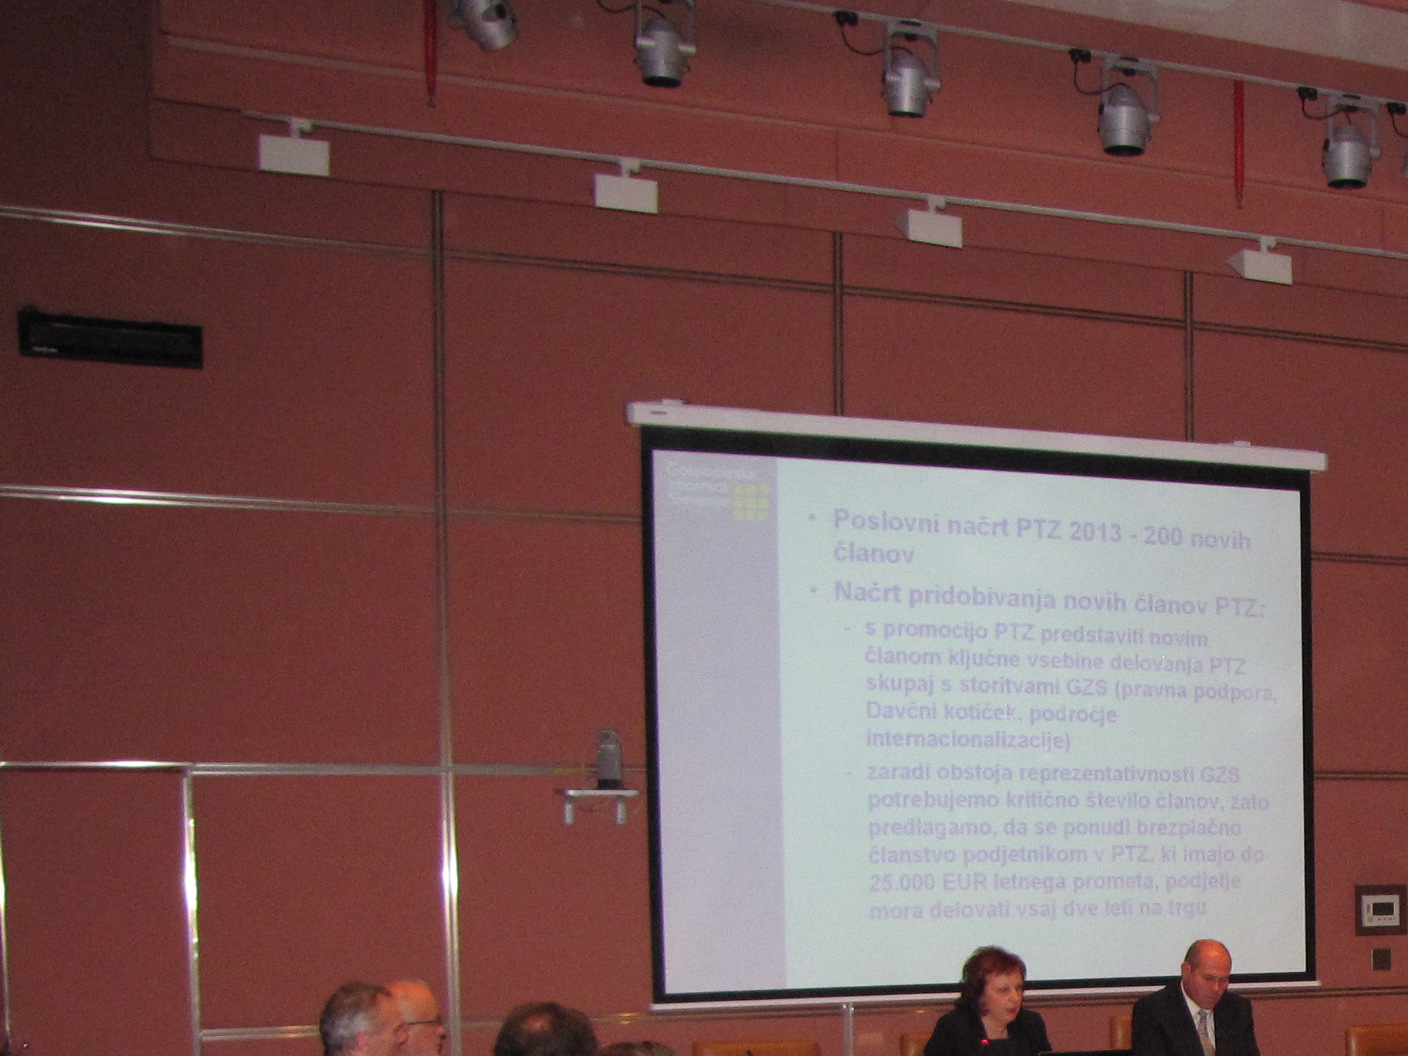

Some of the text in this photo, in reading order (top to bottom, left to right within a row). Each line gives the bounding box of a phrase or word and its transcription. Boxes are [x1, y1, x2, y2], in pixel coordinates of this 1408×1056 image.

[833, 507, 940, 535] Poslovni
[947, 514, 1011, 539] načrt
[1015, 516, 1063, 542] PTZ
[1068, 519, 1122, 544] 2013
[1142, 524, 1183, 547] 200
[1190, 528, 1251, 551] novih
[832, 540, 915, 566] članov
[834, 579, 902, 604] Načrt
[908, 582, 1057, 614] pridobivanja
[1063, 589, 1126, 612] novih
[1134, 593, 1208, 616] članov
[864, 619, 1209, 648] s promocijo PTZ predstaviti novim
[863, 644, 1247, 676] članom ključne vsebine delovanja PTZ
[865, 674, 934, 696] skupaj
[941, 679, 953, 693] s
[959, 676, 1060, 696] storitvami
[1067, 678, 1108, 696] GZS
[1114, 681, 1188, 702] (pravna
[865, 700, 938, 720] Davčni
[1029, 706, 1118, 728] področje
[865, 762, 1241, 785] zaradi obstoja reprezentativnosti GZS
[868, 791, 1000, 812] potrebujemo
[1005, 790, 1080, 808] kritično
[1230, 795, 1271, 810] zato
[1002, 818, 1028, 836] da
[1034, 821, 1058, 835] se
[1063, 819, 1130, 839] ponudi
[1136, 819, 1243, 838] brezplačno
[867, 845, 956, 864] članstvo
[963, 845, 1088, 866] podjetnikom
[1093, 849, 1105, 861] v
[1160, 846, 1176, 862] ki
[1183, 847, 1235, 865] imajo
[1240, 845, 1265, 863] do
[943, 872, 987, 891] EUR
[994, 873, 1067, 895] letnega
[1165, 873, 1242, 893] podjetje
[868, 900, 1207, 922] mora delovati vsaj dve leti na trgu
